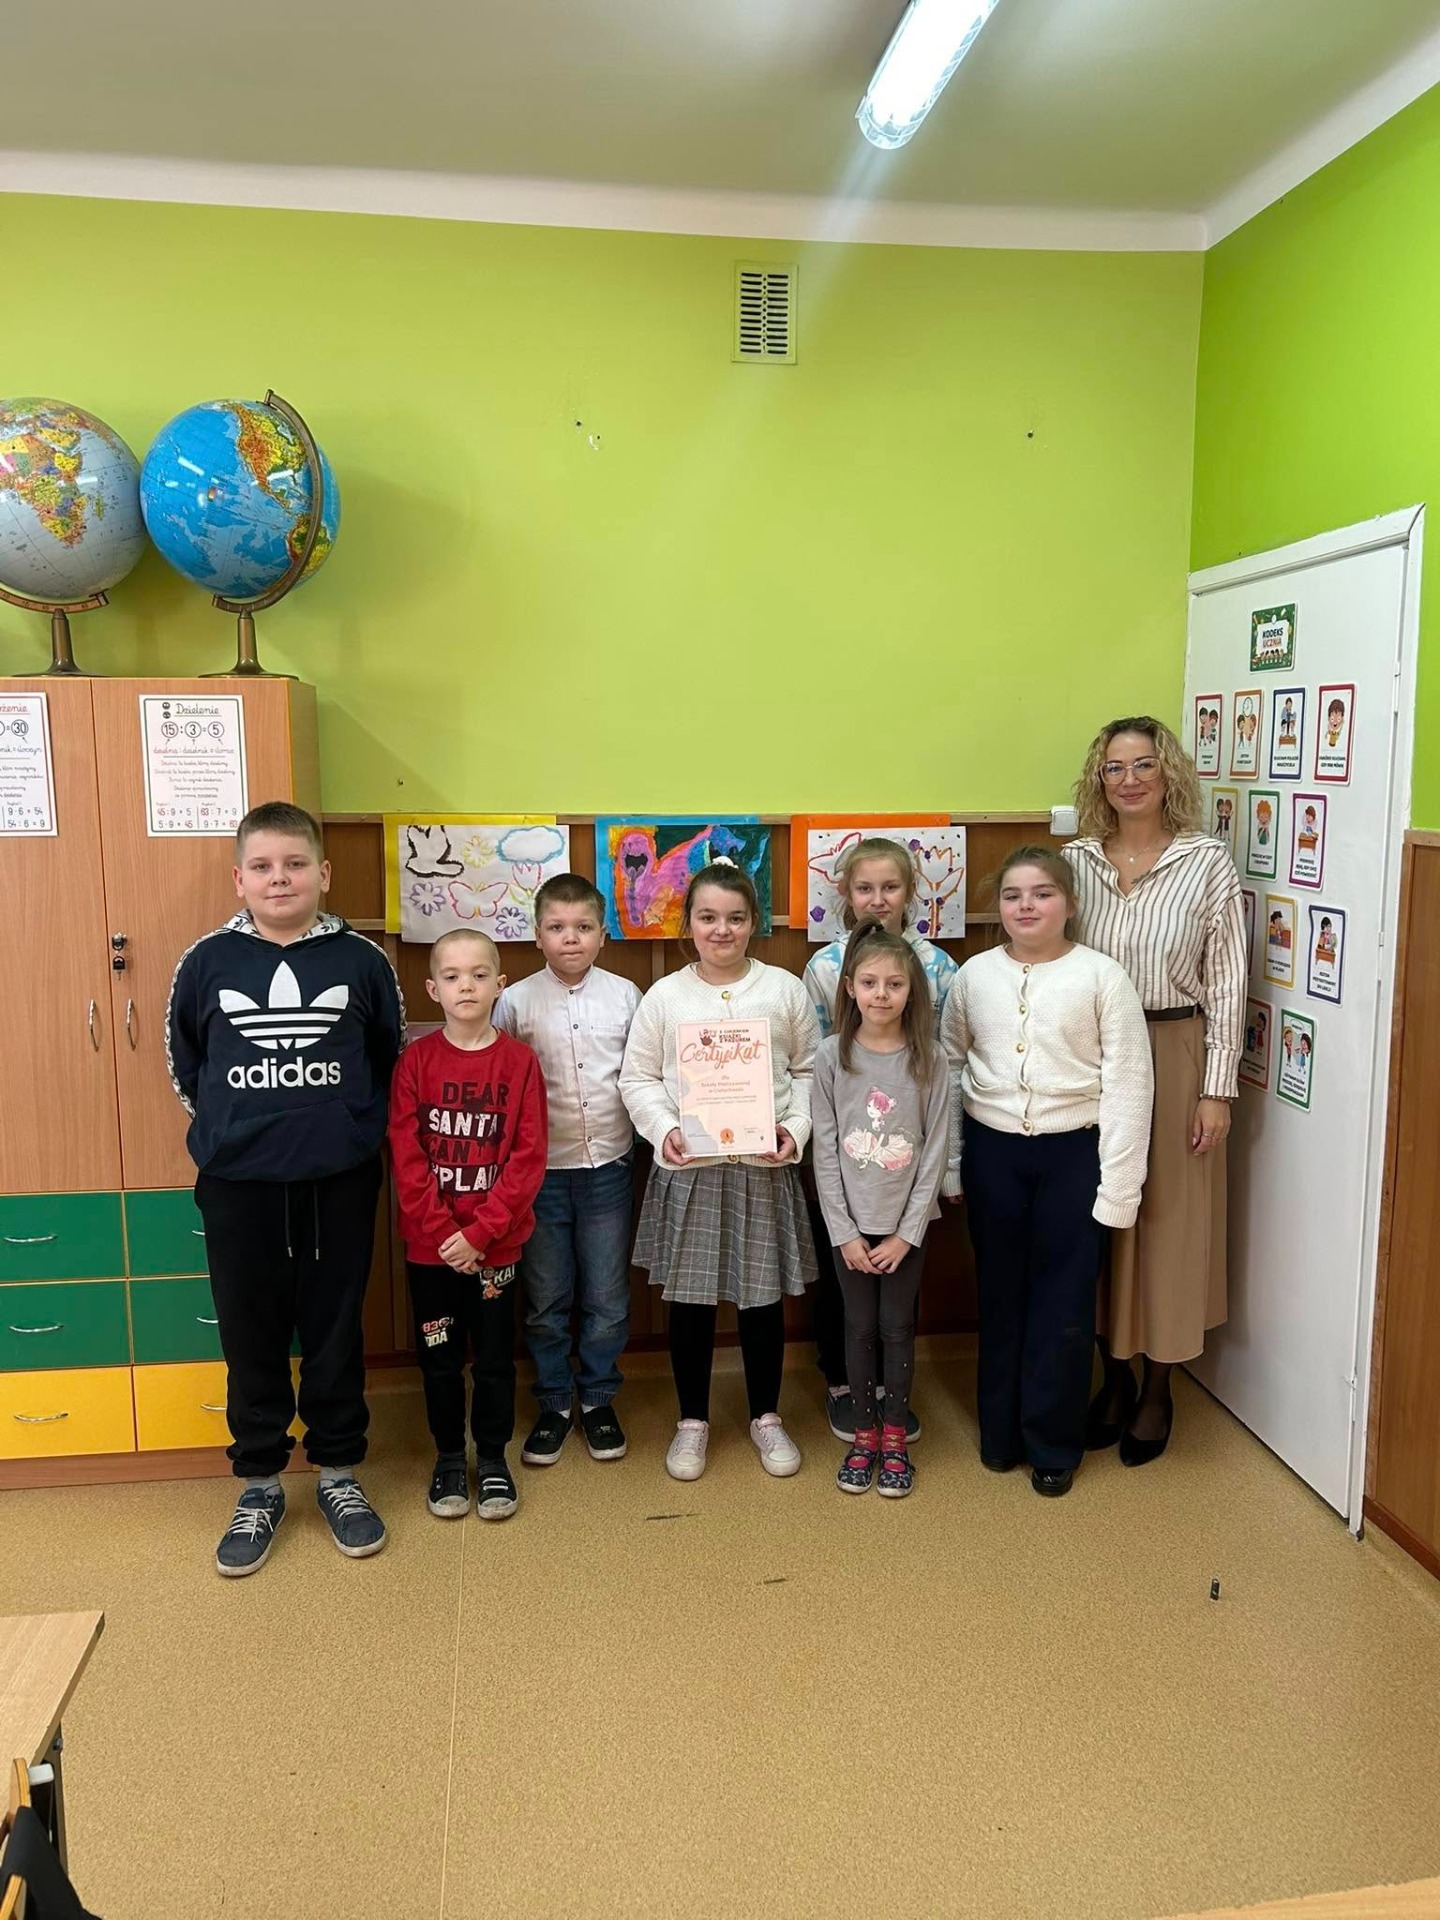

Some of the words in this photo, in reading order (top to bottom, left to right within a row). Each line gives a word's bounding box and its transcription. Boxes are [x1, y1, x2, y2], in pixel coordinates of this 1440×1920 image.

[1263, 627, 1283, 638] KODEKS
[175, 702, 219, 715] Dzielenie
[13, 722, 27, 734] 30
[164, 724, 176, 736] 15
[189, 724, 197, 736] 3
[212, 724, 220, 736] 5
[680, 1040, 767, 1070] Certyfikat
[227, 1056, 341, 1089] adidas
[442, 1081, 510, 1106] DEAR
[428, 1108, 498, 1137] SANTA
